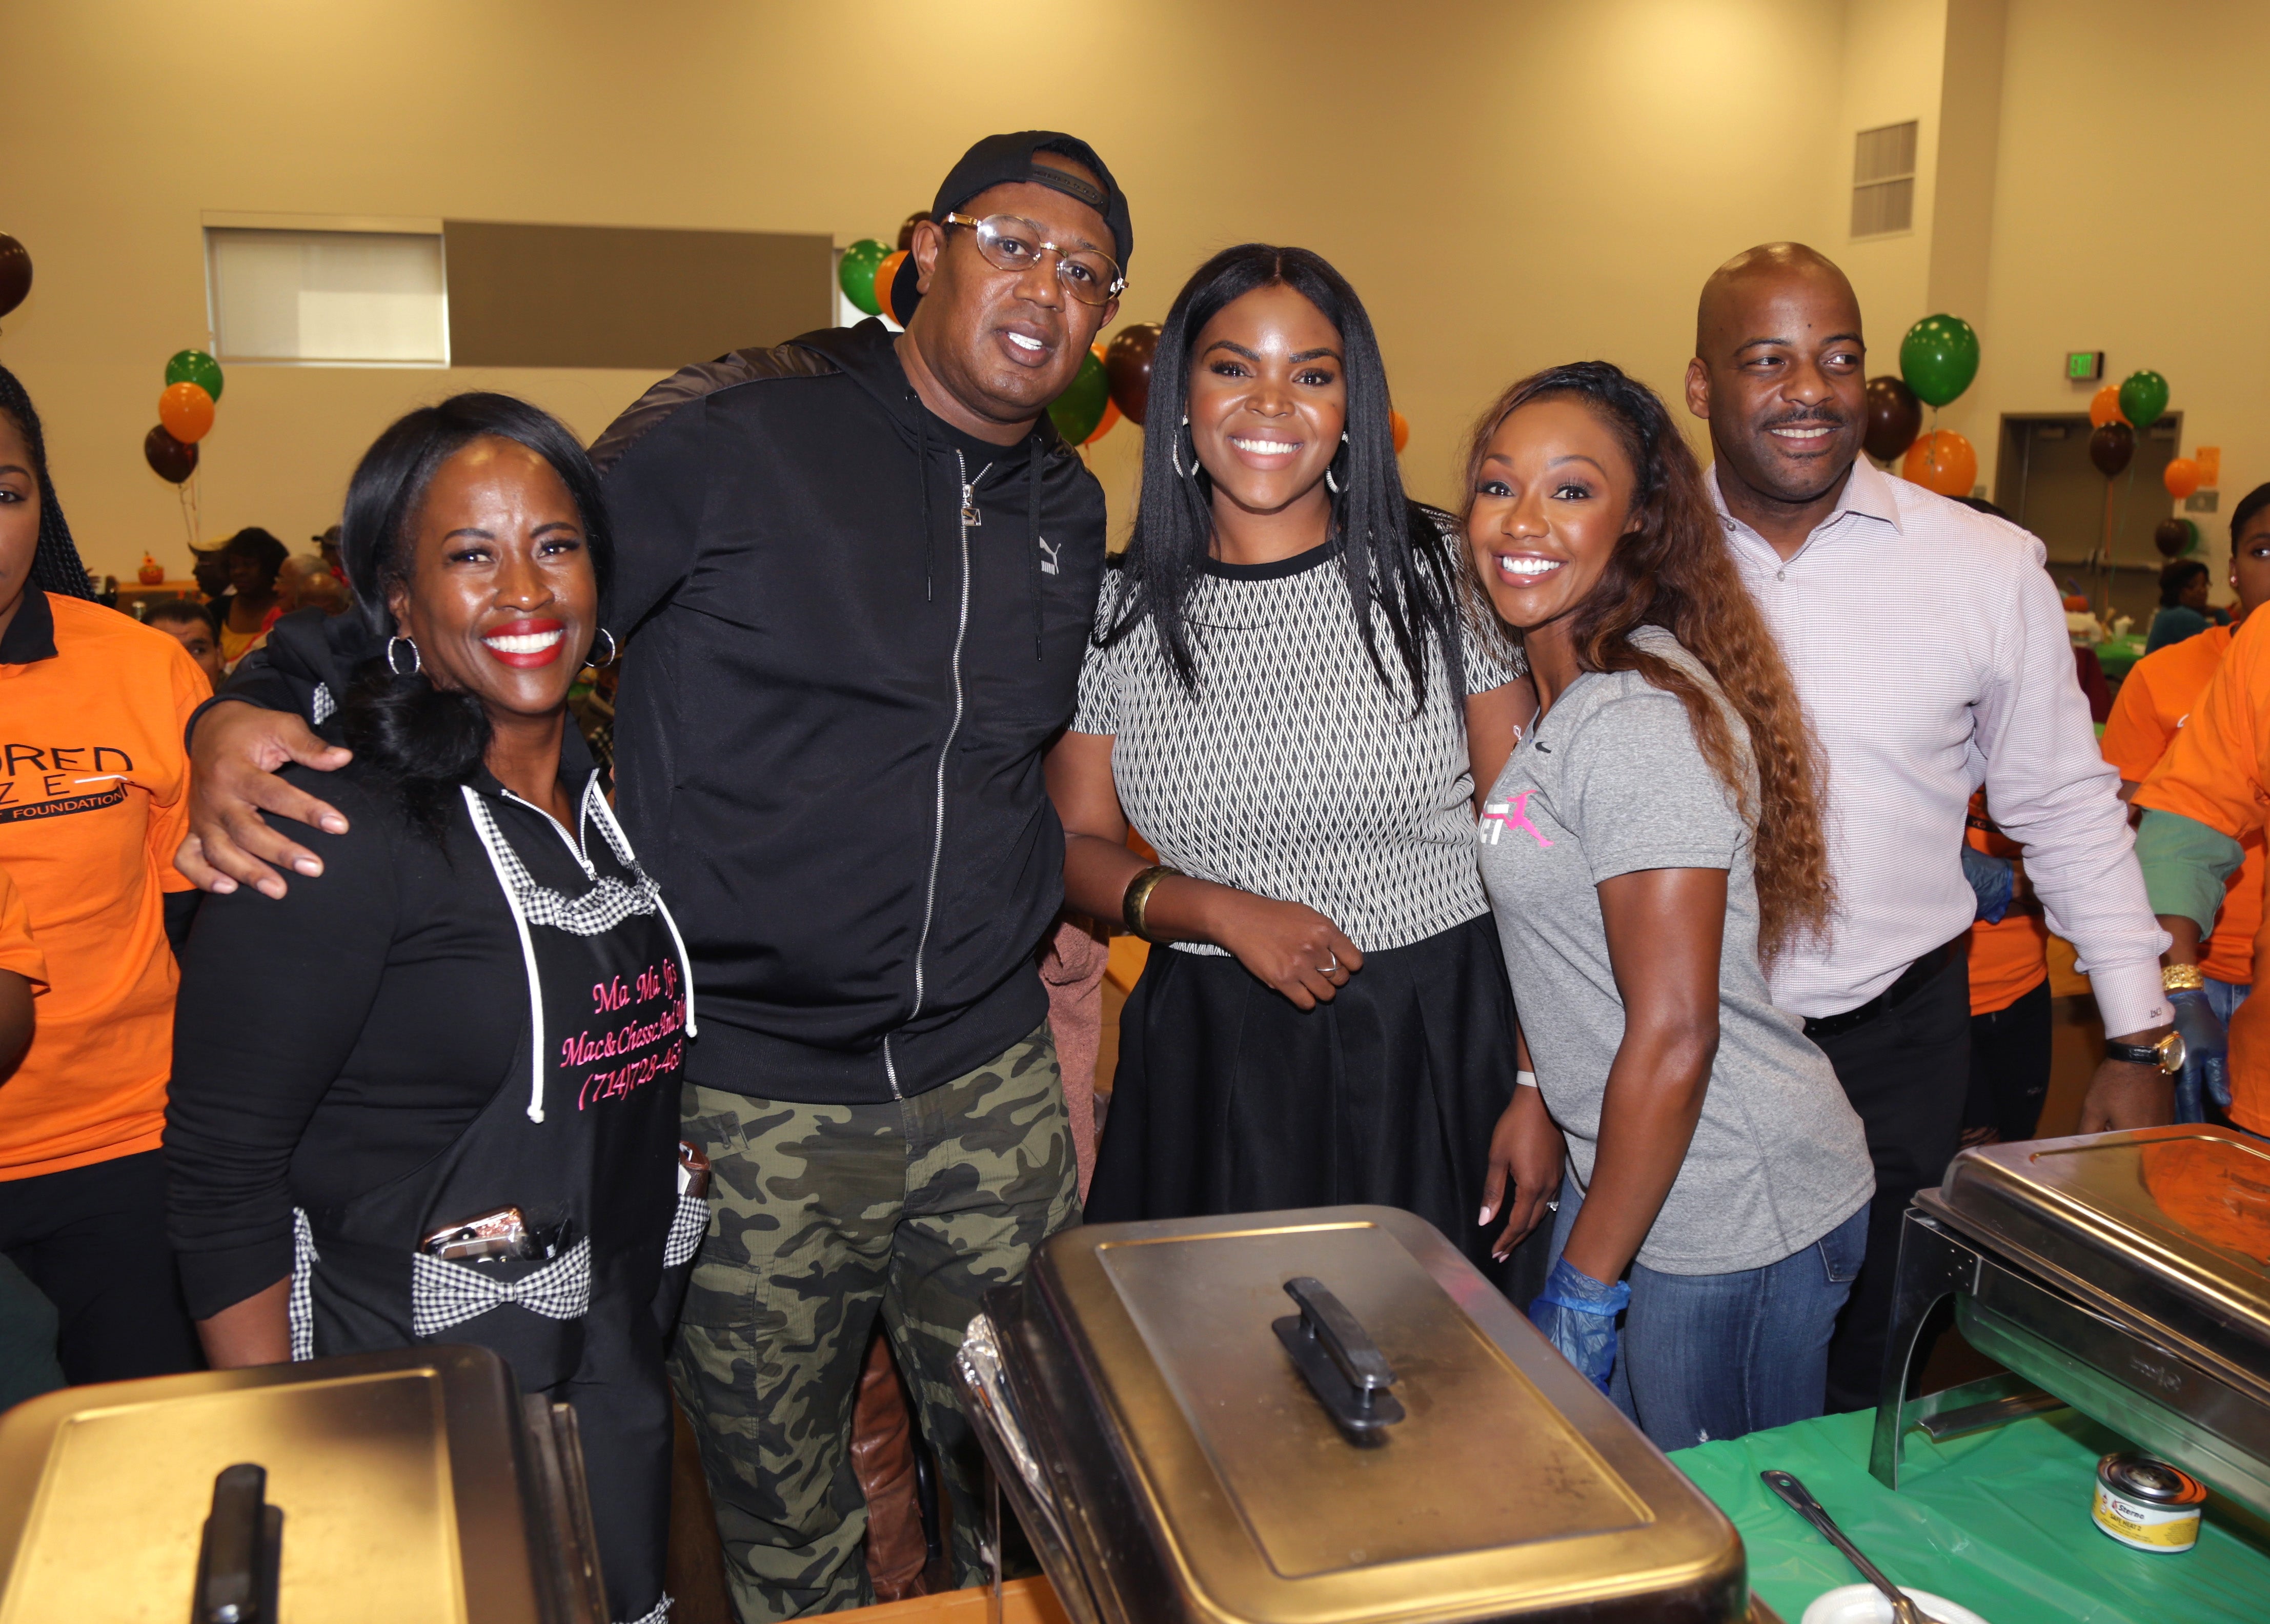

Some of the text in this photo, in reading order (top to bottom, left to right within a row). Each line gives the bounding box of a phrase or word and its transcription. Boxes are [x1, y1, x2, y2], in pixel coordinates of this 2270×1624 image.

[0, 744, 133, 776] RED
[13, 793, 121, 818] FOUNDATION
[593, 975, 631, 1014] Ma
[636, 965, 660, 1004] Ma
[2110, 1513, 2122, 1524] SAFE
[2122, 1520, 2137, 1530] HEAT
[2118, 1505, 2145, 1520] Sterno
